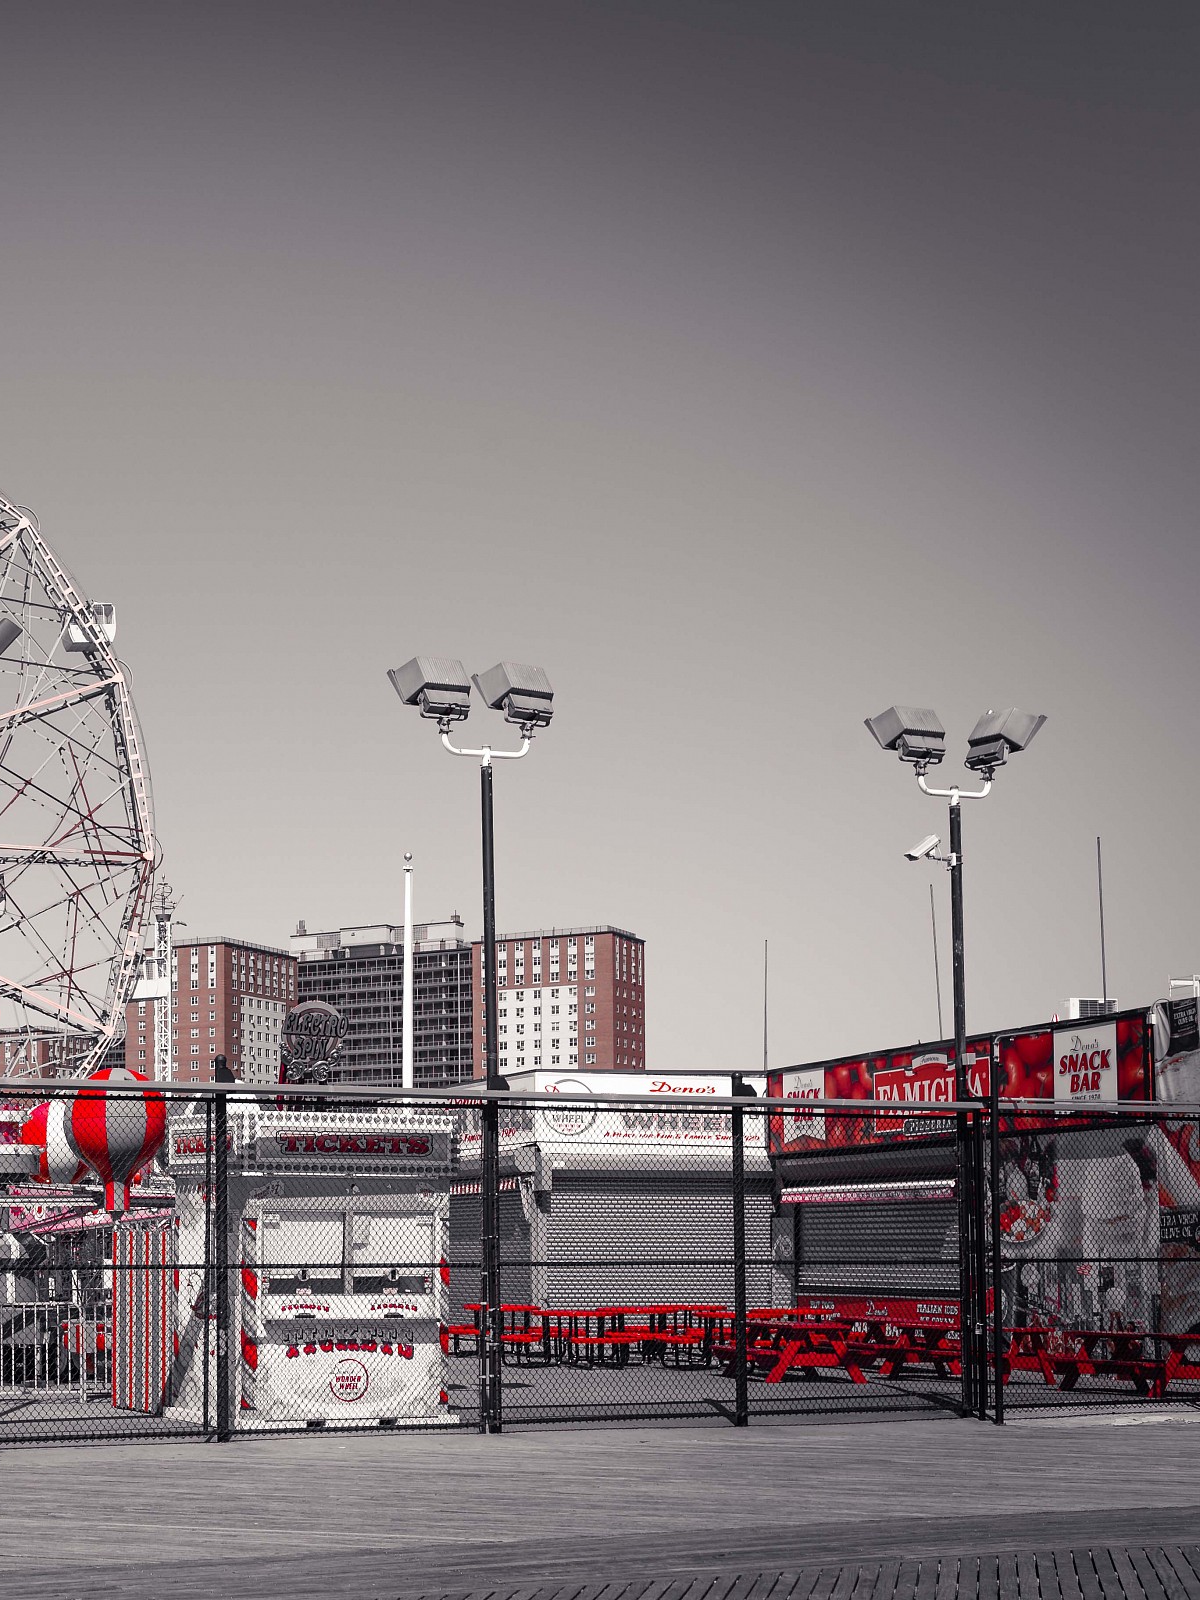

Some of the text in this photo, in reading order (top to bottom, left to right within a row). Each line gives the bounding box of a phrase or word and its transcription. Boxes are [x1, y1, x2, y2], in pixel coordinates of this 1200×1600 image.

[283, 1012, 348, 1038] ELECTRO
[292, 1036, 328, 1060] SPIN
[1070, 1035, 1099, 1052] Deno's
[1059, 1048, 1112, 1075] SNACK
[649, 1080, 716, 1094] Deno's
[1070, 1071, 1101, 1094] BAR
[280, 1134, 430, 1154] TICKETS
